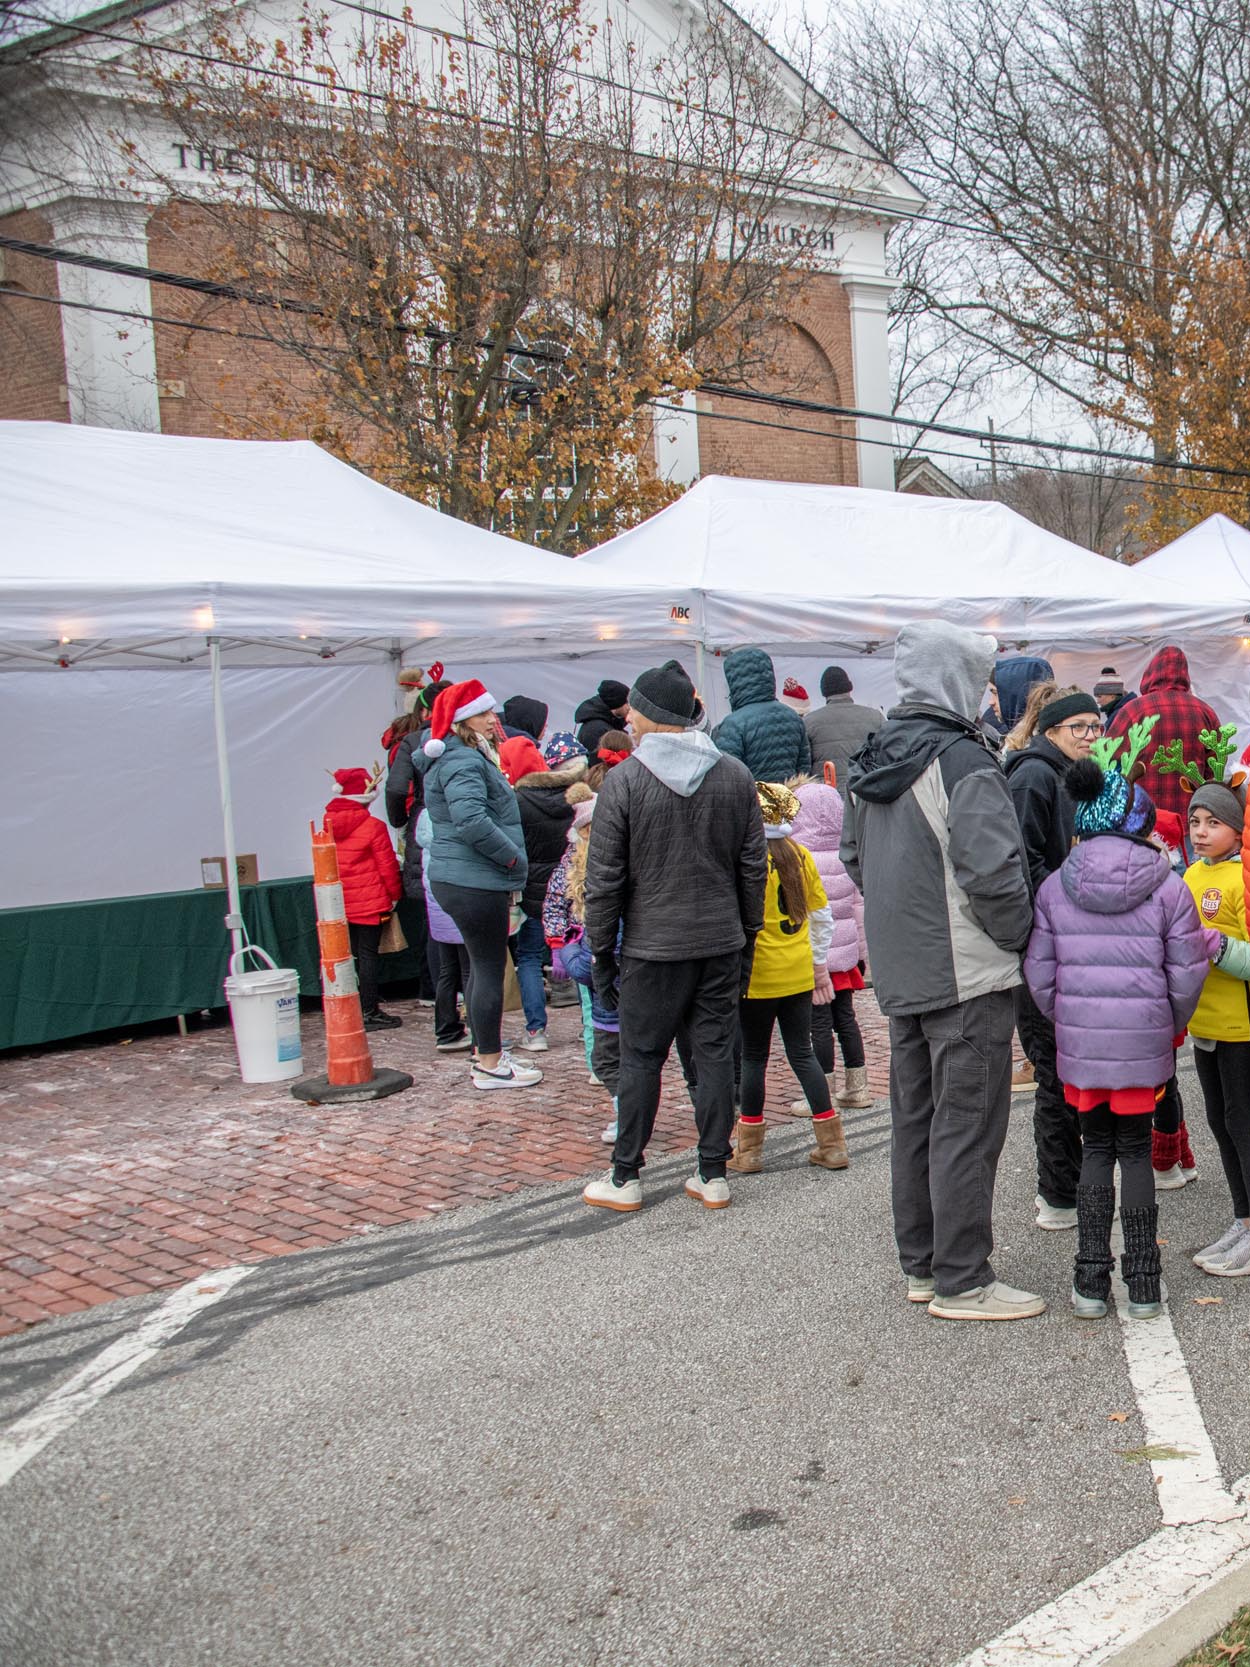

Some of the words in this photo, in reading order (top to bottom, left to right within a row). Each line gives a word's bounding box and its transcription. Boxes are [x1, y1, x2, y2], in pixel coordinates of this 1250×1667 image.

[172, 143, 243, 175] THE
[739, 221, 835, 250] CHURCH
[670, 606, 690, 619] ABC
[1203, 901, 1217, 909] BEES
